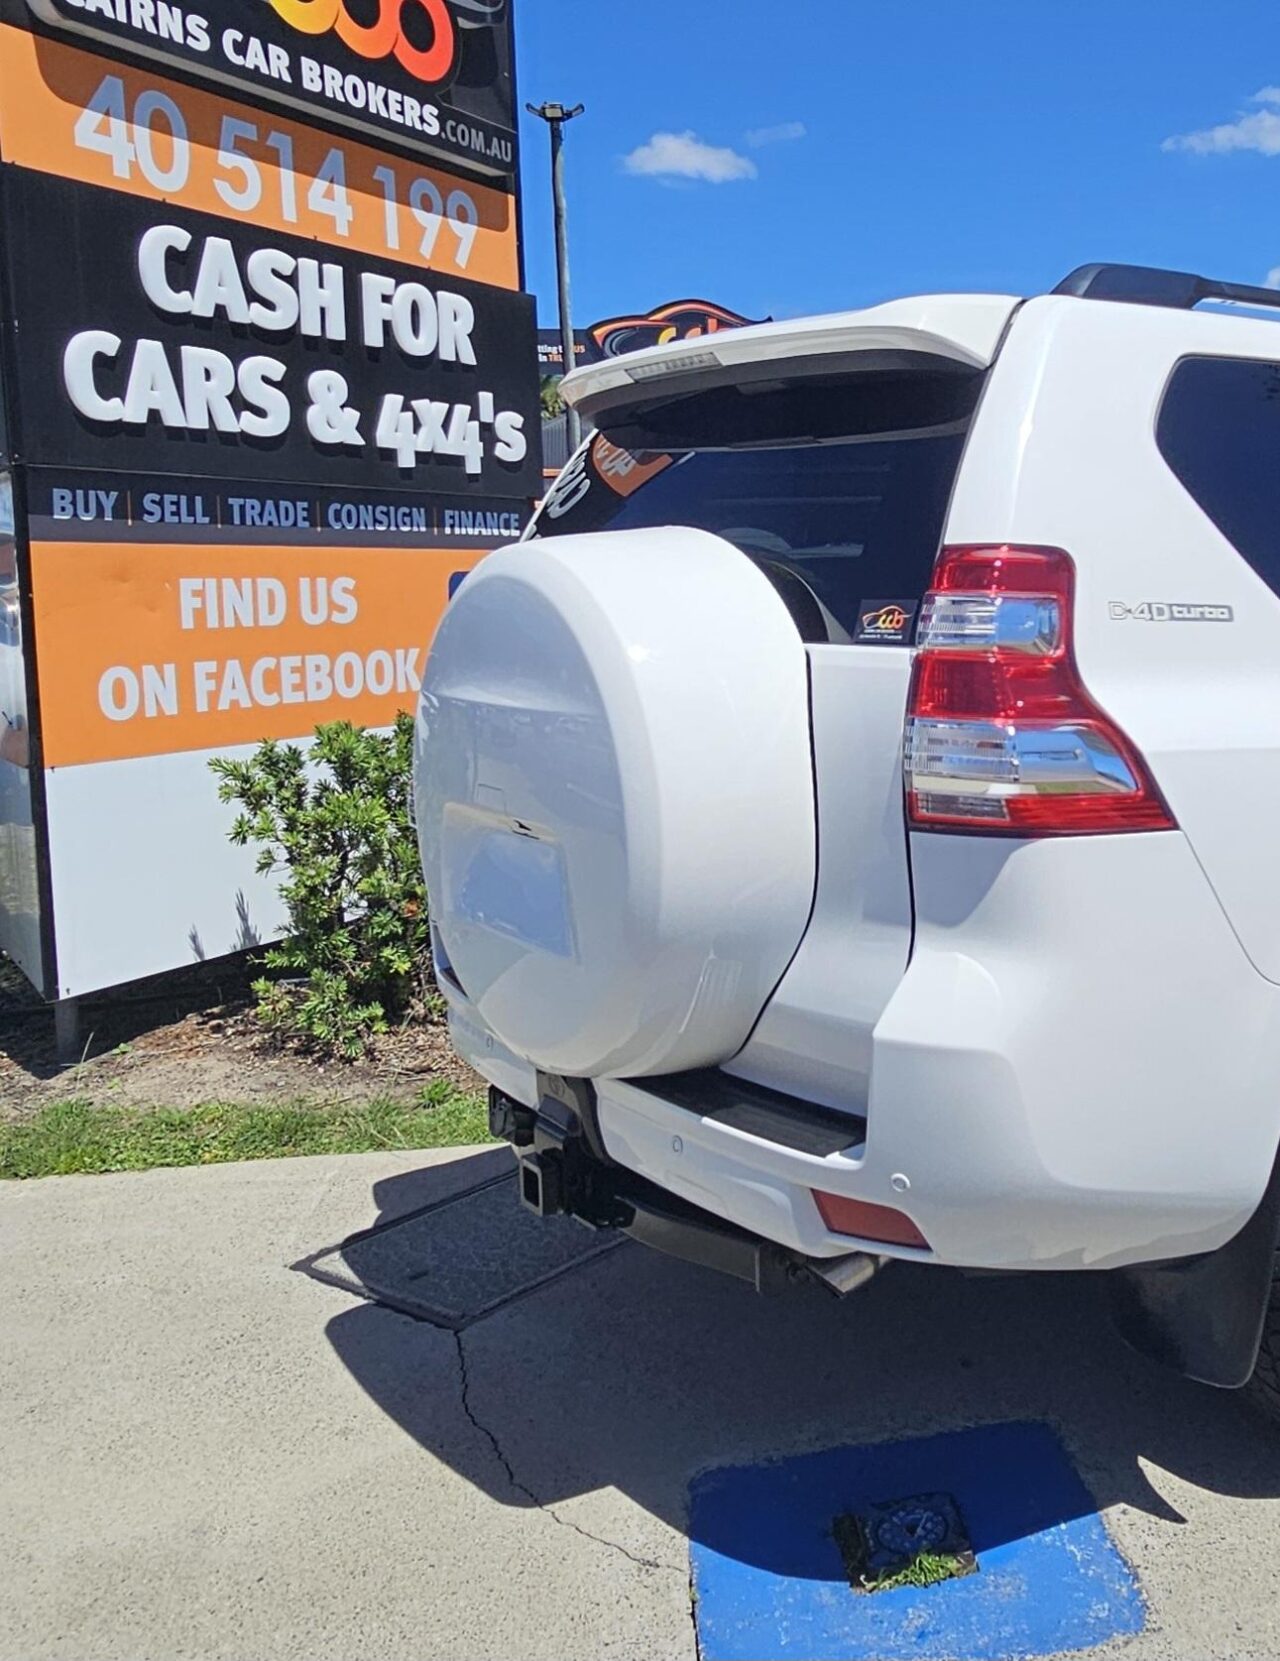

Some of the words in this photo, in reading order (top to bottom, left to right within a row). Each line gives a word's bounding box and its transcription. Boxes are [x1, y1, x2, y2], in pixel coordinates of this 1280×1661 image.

[64, 0, 211, 51] AIRNS
[222, 28, 293, 83] CAR
[74, 74, 190, 192] 40
[213, 114, 353, 237] 514
[373, 166, 478, 269] 199
[138, 225, 346, 341] CASH
[361, 272, 477, 365] FOR
[64, 330, 291, 437] CARS
[306, 369, 366, 446] &
[52, 488, 119, 520] BUY
[143, 493, 210, 525] SELL
[228, 498, 310, 528] TRADE
[327, 503, 427, 532] CONSIGN
[444, 510, 520, 537] FINANCE
[179, 577, 287, 629] FIND
[299, 576, 359, 625] US
[1108, 601, 1171, 621] D-4D
[1171, 605, 1231, 620] turbo
[98, 662, 178, 721] ON
[193, 648, 421, 713] FACEBOOK
